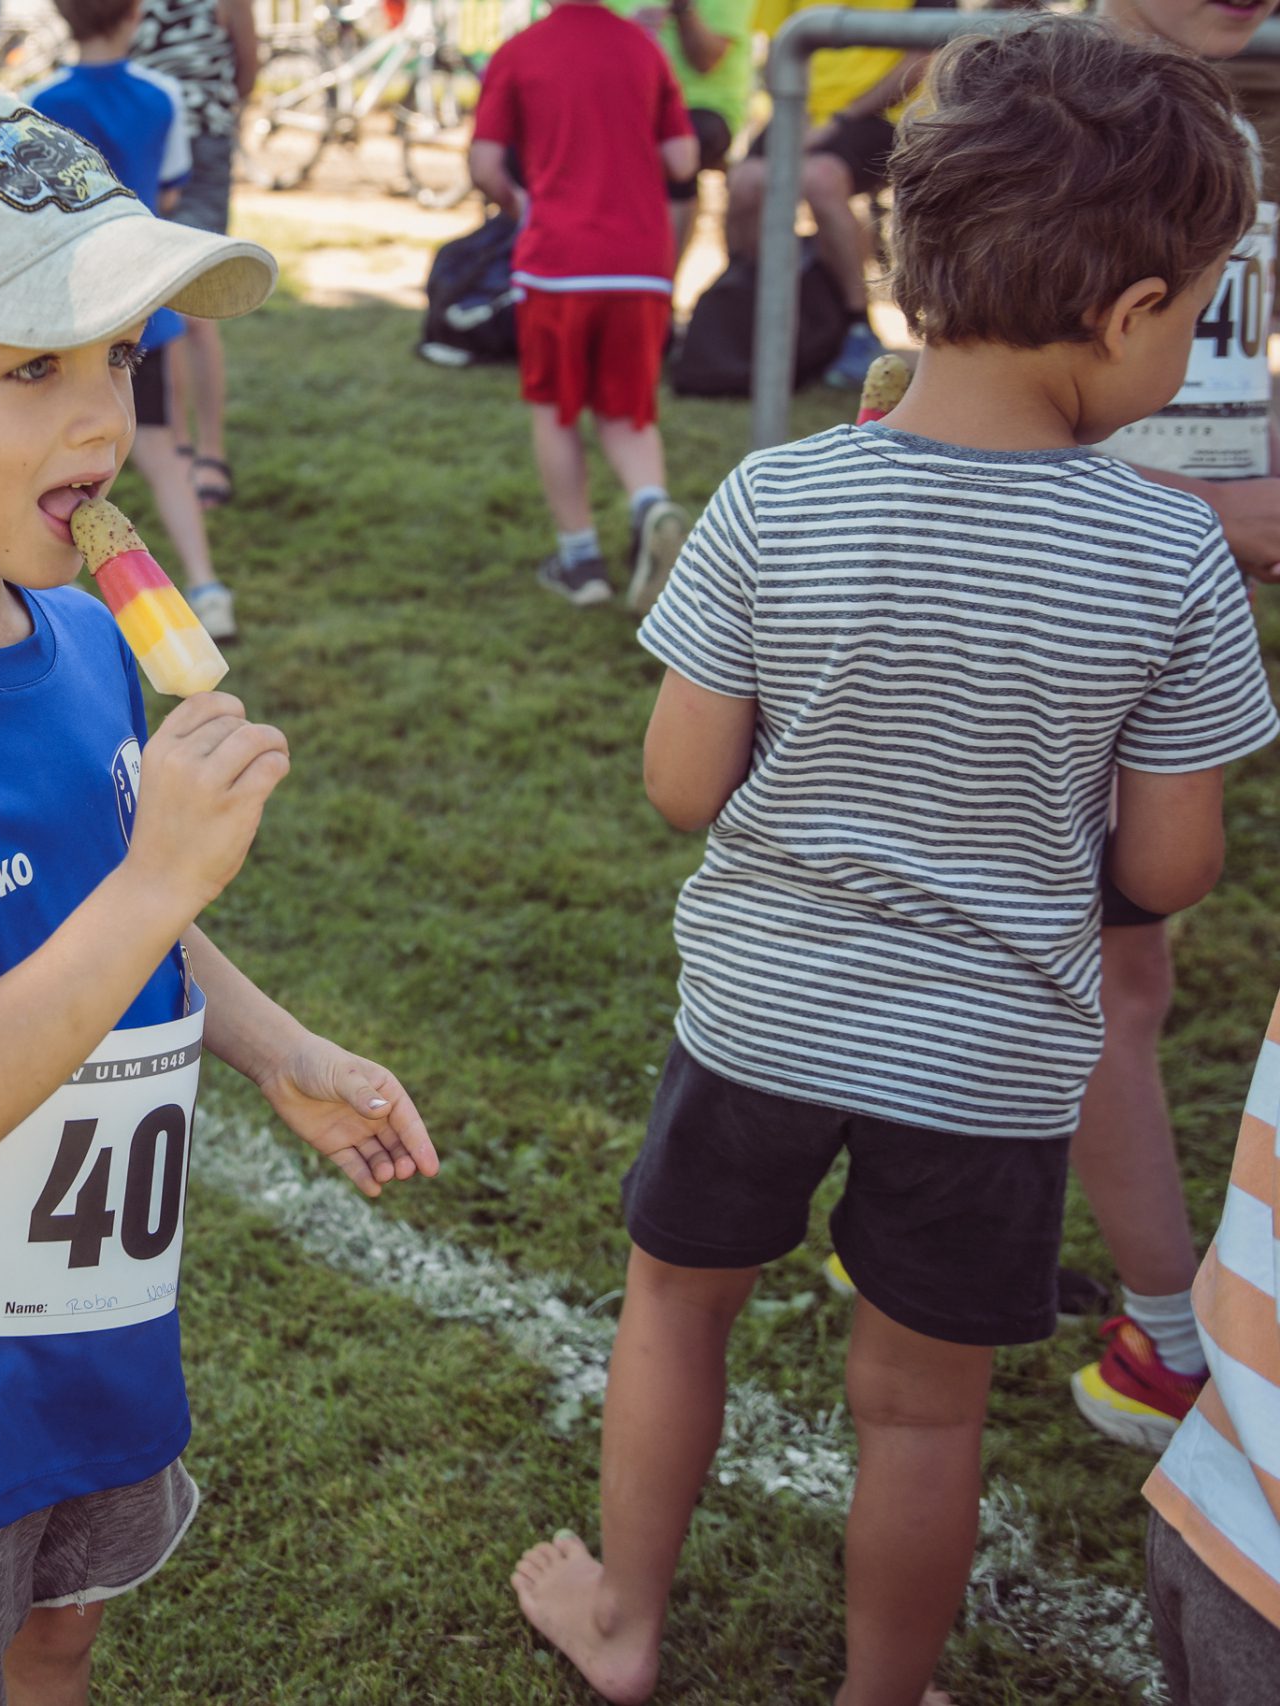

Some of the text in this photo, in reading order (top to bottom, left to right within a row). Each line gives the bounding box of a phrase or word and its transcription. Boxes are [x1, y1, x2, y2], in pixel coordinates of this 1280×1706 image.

[1195, 256, 1262, 358] 40
[95, 1062, 142, 1081] ULM
[150, 1051, 186, 1073] 1948
[27, 1103, 186, 1269] 40
[4, 1301, 49, 1315] Name:
